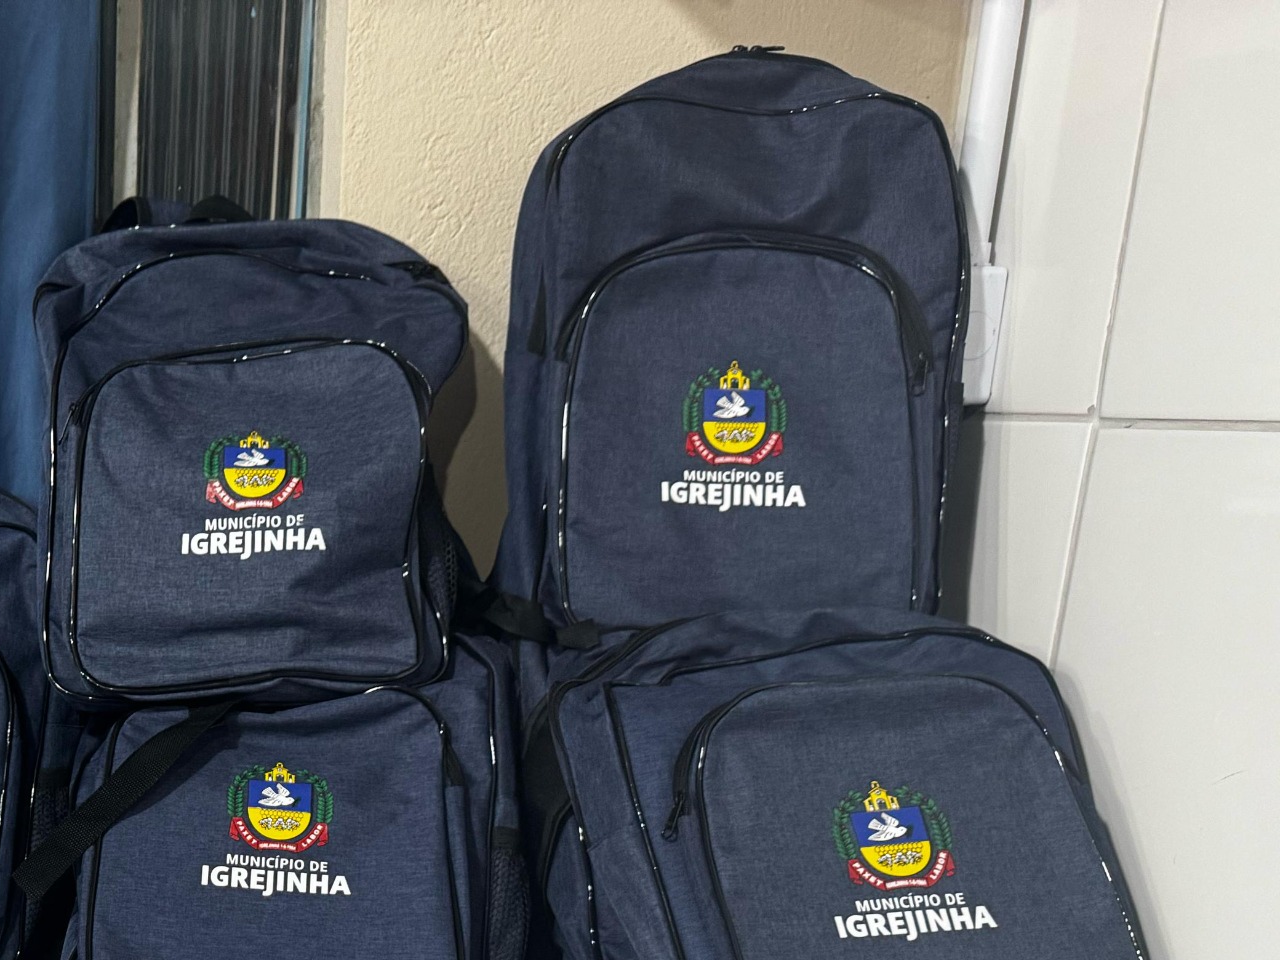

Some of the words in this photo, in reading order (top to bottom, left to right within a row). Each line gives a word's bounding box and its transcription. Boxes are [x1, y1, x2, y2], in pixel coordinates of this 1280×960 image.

[683, 468, 761, 483] MUNICÍPIO
[765, 471, 784, 483] DE
[661, 481, 806, 512] IGREJINHA
[205, 513, 281, 531] MUNICÍPIO
[286, 514, 305, 526] DE
[181, 528, 327, 560] IGREJINHA
[226, 854, 305, 870] MUNICÍPIO
[309, 860, 328, 873] DE
[201, 865, 351, 896] IGREJINHA
[854, 893, 941, 912] MUNICÍPIO
[945, 893, 966, 905] DE
[834, 905, 998, 941] IGREJINHA
